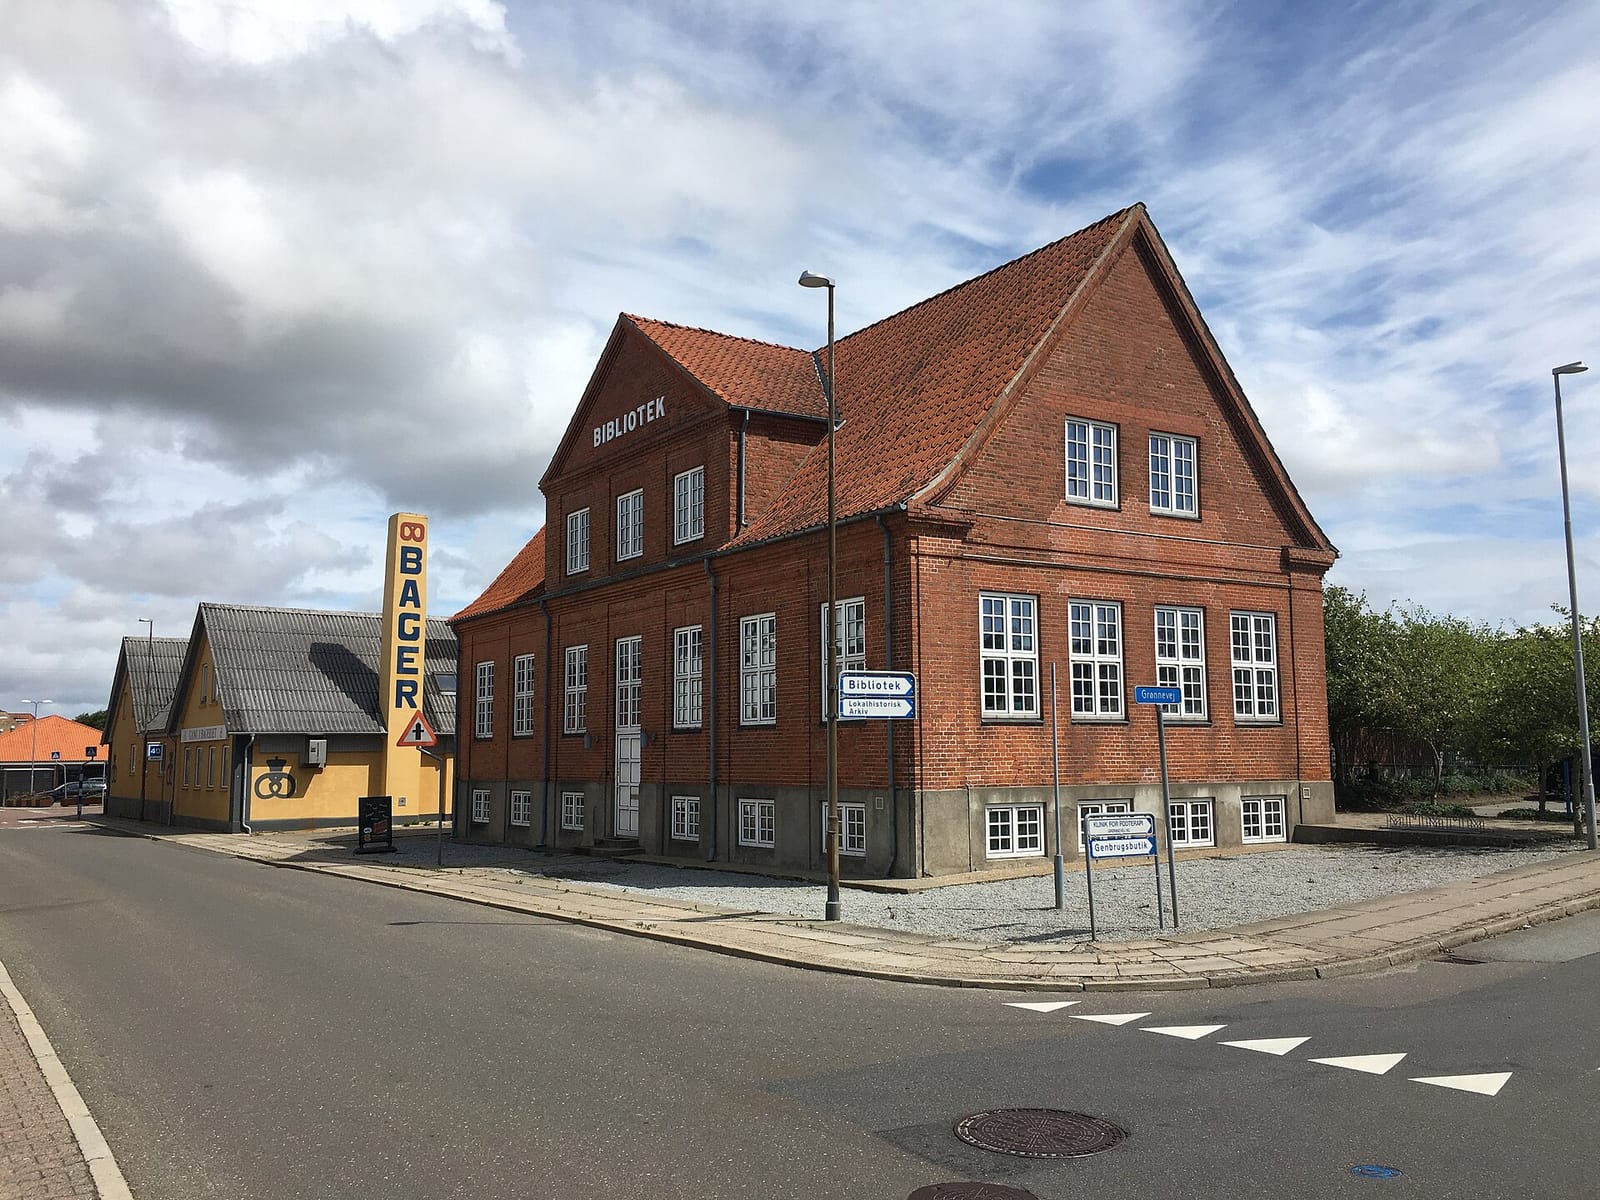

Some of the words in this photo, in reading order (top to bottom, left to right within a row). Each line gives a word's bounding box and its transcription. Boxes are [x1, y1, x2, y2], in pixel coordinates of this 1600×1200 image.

[593, 396, 666, 448] BIBLIOTEK
[395, 546, 423, 709] BAGER
[848, 680, 901, 690] Bibliotek
[848, 700, 902, 708] Lokalhistorisk
[849, 707, 869, 715] Arkiv
[1108, 820, 1119, 828] FOR
[1094, 842, 1149, 852] Genbrugsbutik
